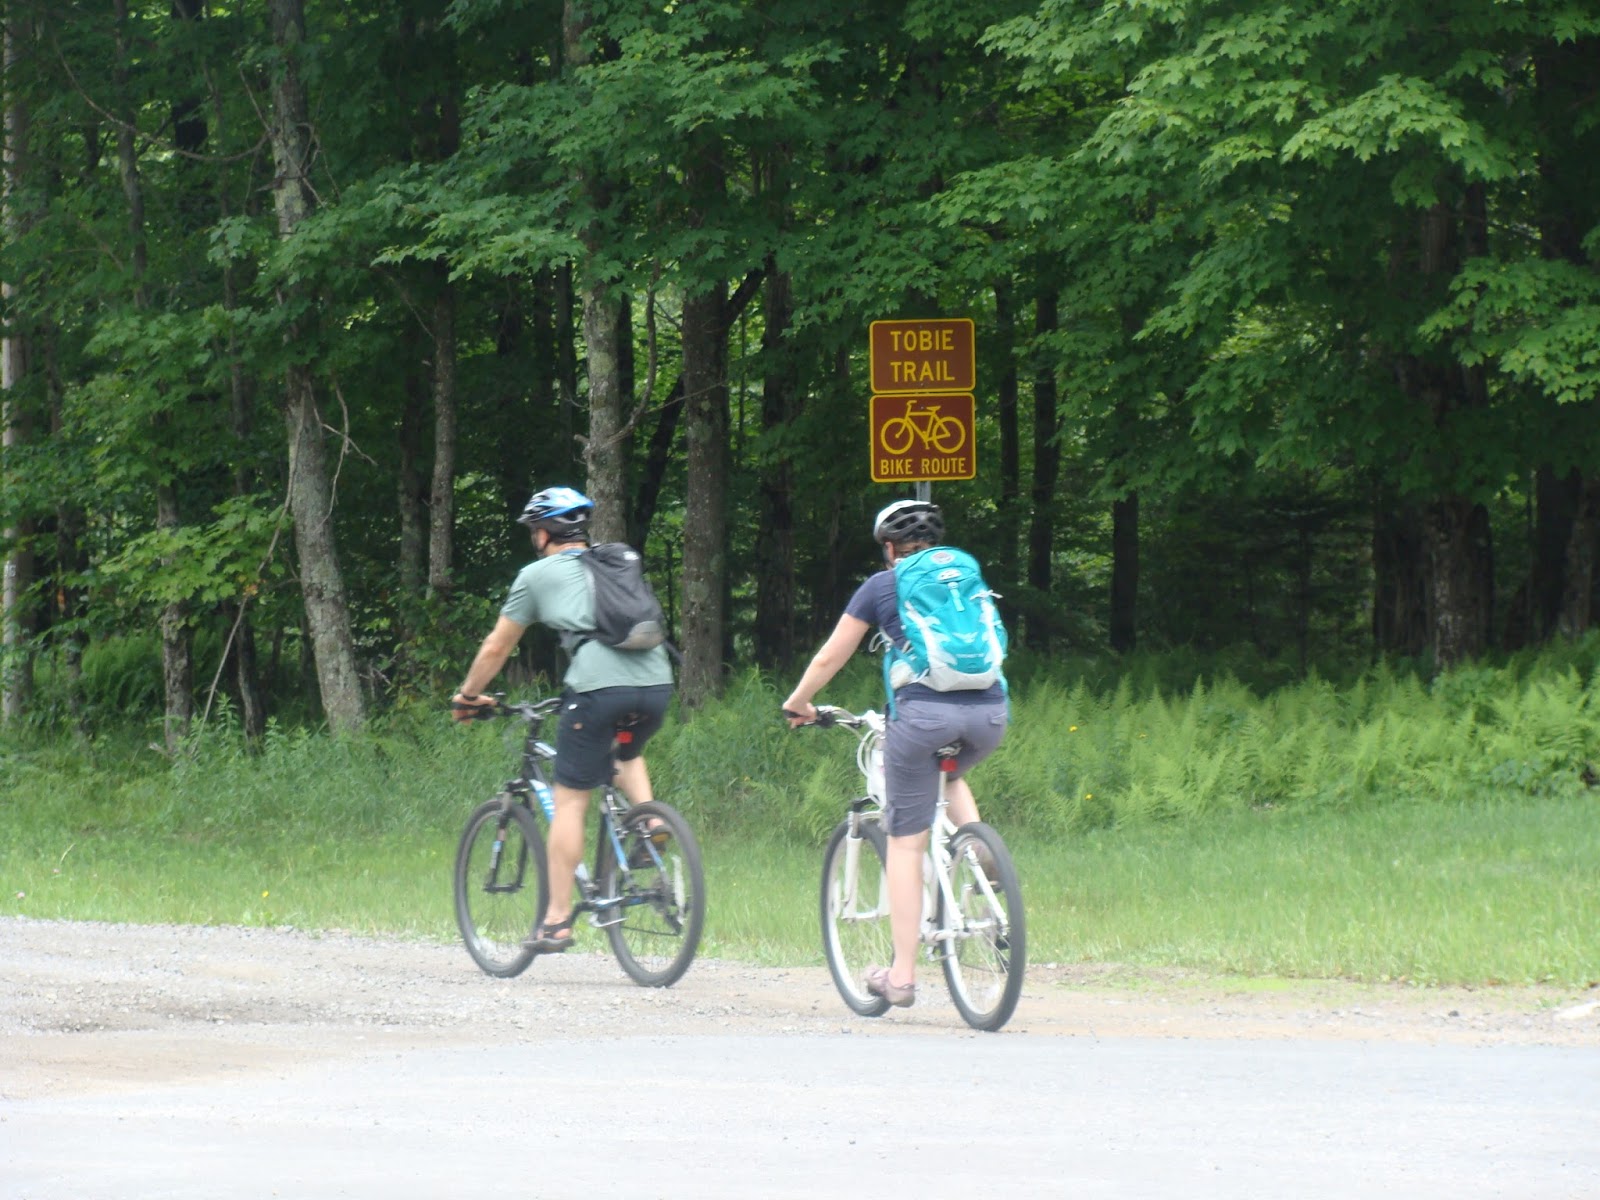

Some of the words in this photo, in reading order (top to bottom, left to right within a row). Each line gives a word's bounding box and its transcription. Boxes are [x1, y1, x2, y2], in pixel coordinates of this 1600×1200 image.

[890, 330, 954, 351] TOBIE
[890, 361, 955, 382] TRAIL
[880, 459, 913, 475] BIKE
[921, 457, 966, 474] ROUTE
